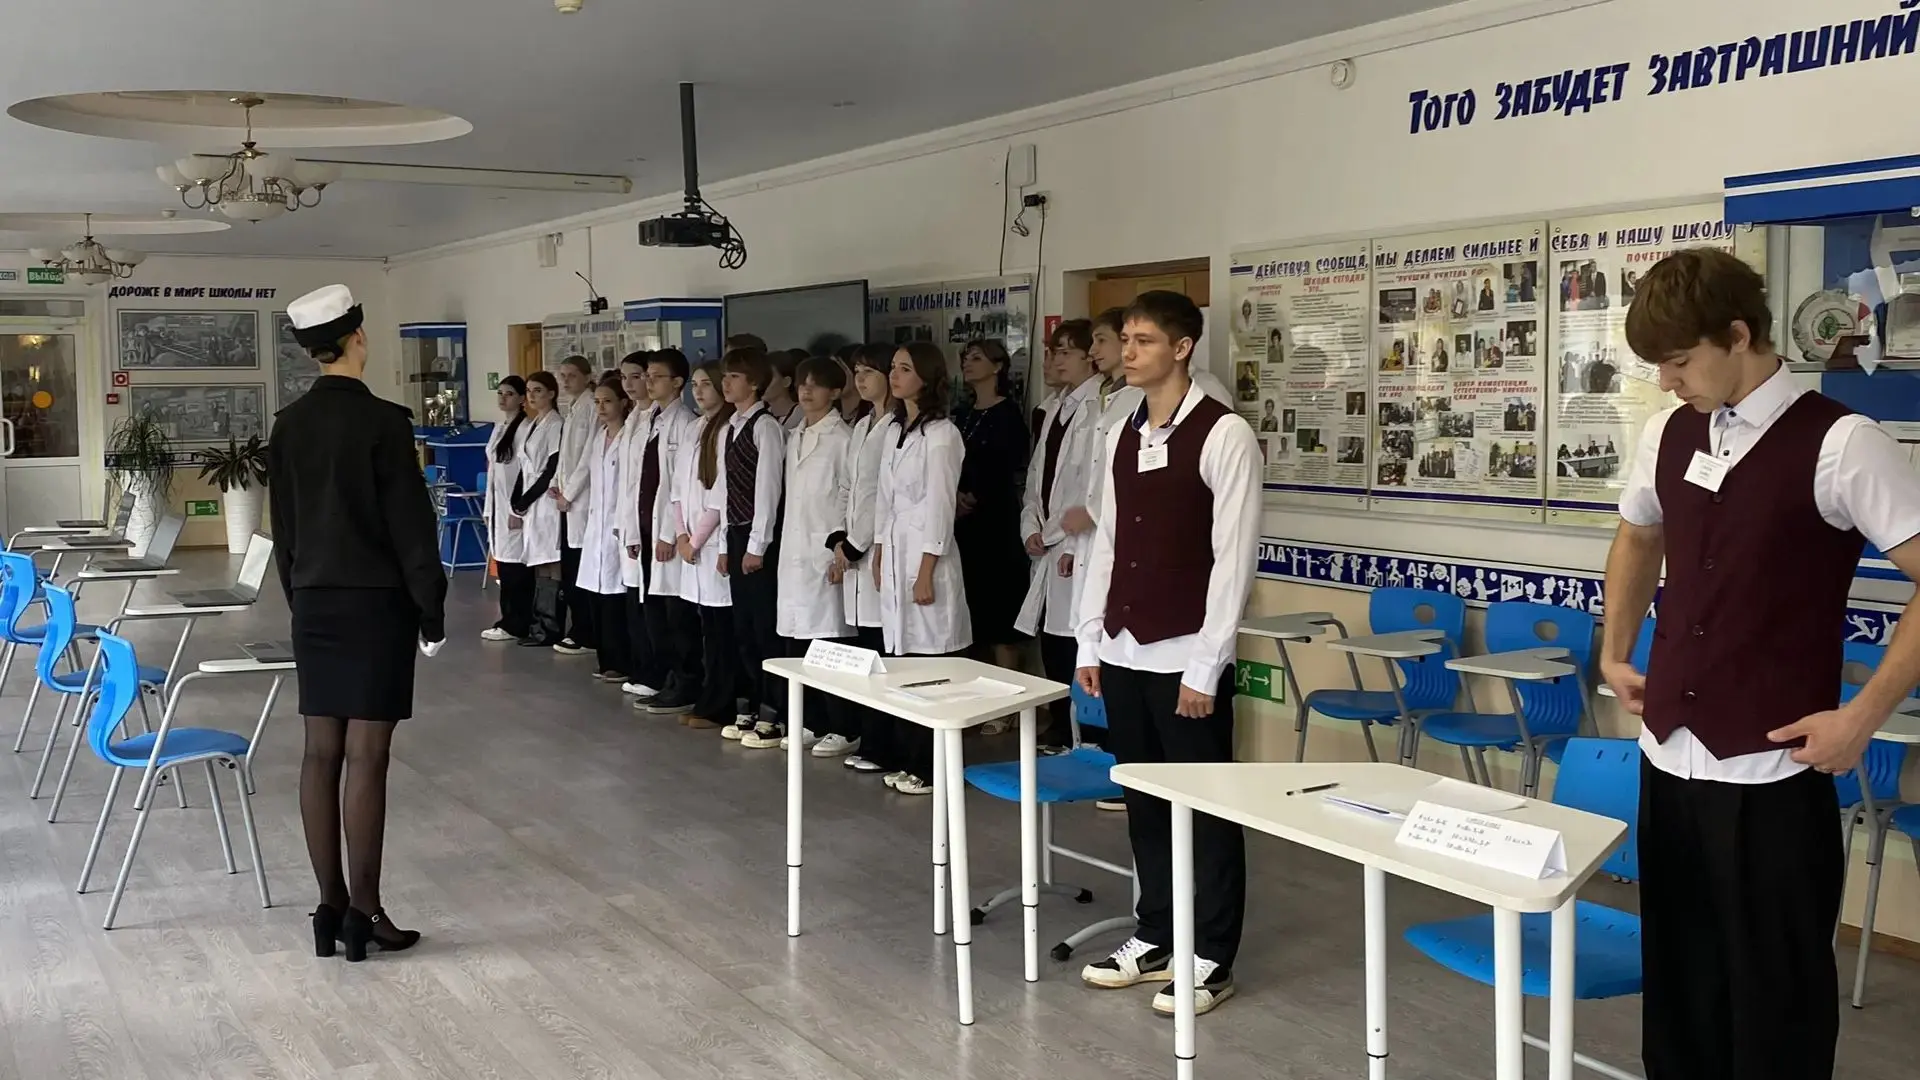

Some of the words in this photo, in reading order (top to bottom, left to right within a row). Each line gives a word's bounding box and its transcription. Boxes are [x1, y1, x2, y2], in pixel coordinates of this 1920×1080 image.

[1409, 88, 1476, 134] Того
[1494, 62, 1630, 120] ЗАБУДЕТ
[1647, 0, 1920, 96] ЗАВТРАШНИЙ
[1255, 261, 1310, 280] ДЕЙСТВУЯ
[1316, 254, 1369, 273] СООБЩА,
[1375, 251, 1398, 268] МЫ
[1404, 246, 1455, 267] ДЕЛАЕМ
[1462, 239, 1522, 260] СИЛЬНЕЕ
[1529, 237, 1539, 253] И
[1552, 233, 1589, 251] СЕБЯ
[1597, 231, 1608, 247] И
[1616, 225, 1664, 246] НАШУ
[1672, 219, 1733, 242] ШКОЛУ
[109, 286, 160, 299] ДОРОЖЕ
[164, 287, 172, 298] В
[209, 287, 252, 299] ШКОЛЫ
[256, 288, 276, 299] НЕТ
[899, 291, 961, 312] ШКОЛЬНЫЕ
[967, 288, 1005, 308] БУДНИ
[1406, 562, 1428, 578] АБ
[1502, 579, 1522, 593] 1+1
